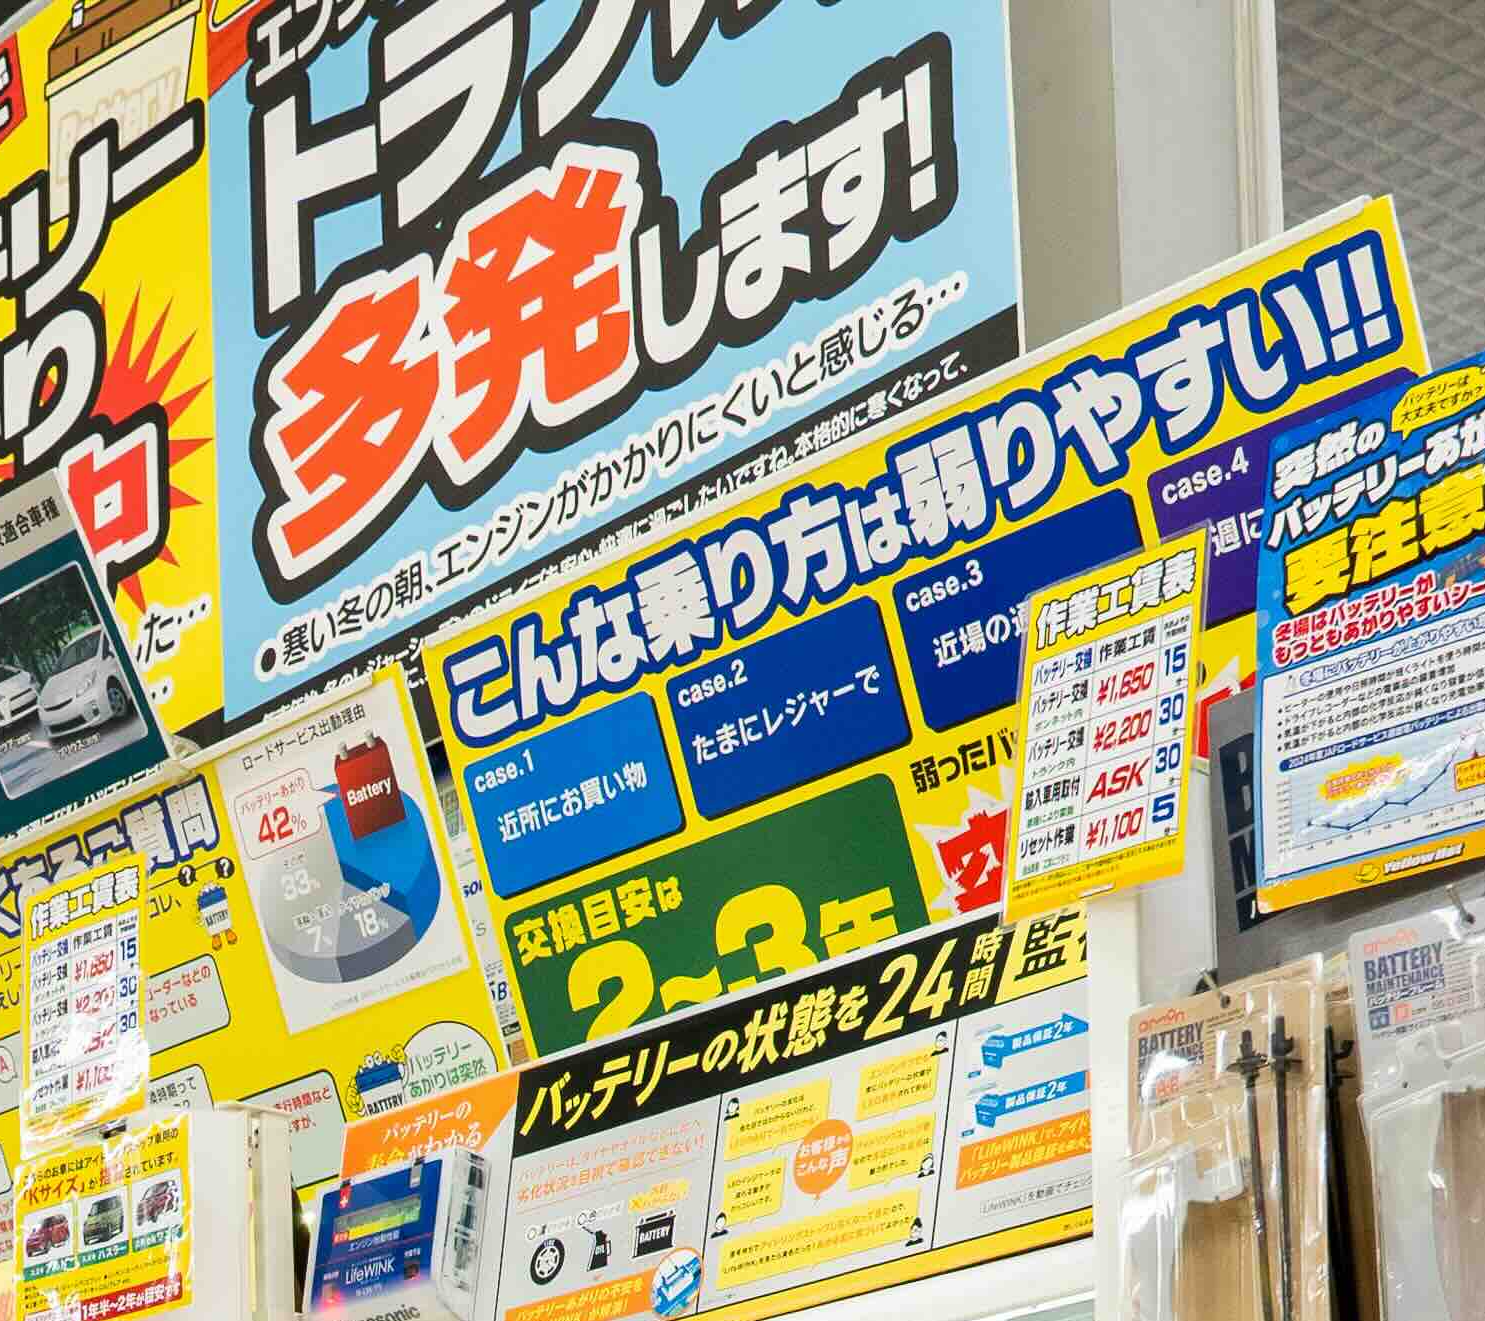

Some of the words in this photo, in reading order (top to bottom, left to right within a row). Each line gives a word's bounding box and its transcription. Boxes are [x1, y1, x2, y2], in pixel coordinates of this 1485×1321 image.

[273, 67, 938, 562] 多発します!
[453, 245, 1394, 735] こんな乗り方は弱りやすい!!
[905, 563, 985, 612] case.3
[1036, 548, 1198, 650] 作業工賃表
[1274, 572, 1437, 643] 冬場はバッテリーが
[1097, 661, 1156, 705] ¥1,650
[1164, 643, 1188, 677] 15
[1099, 626, 1157, 664] 作業工賃
[676, 661, 748, 709] case.2
[241, 701, 367, 773] ロードサービス出動理由
[691, 667, 882, 767] たまにレジャーで
[1093, 709, 1154, 752] ¥2,200
[1158, 694, 1186, 725] 30
[346, 773, 393, 807] Battery
[474, 742, 535, 794] case.1
[1085, 758, 1152, 804] ASK
[257, 806, 309, 845] 42%
[496, 761, 650, 843] 近所にお買い物
[1085, 806, 1145, 850] ¥1,100
[1152, 794, 1176, 824] 5
[515, 876, 684, 967] 交換目安は
[1364, 941, 1444, 980] BATTERY
